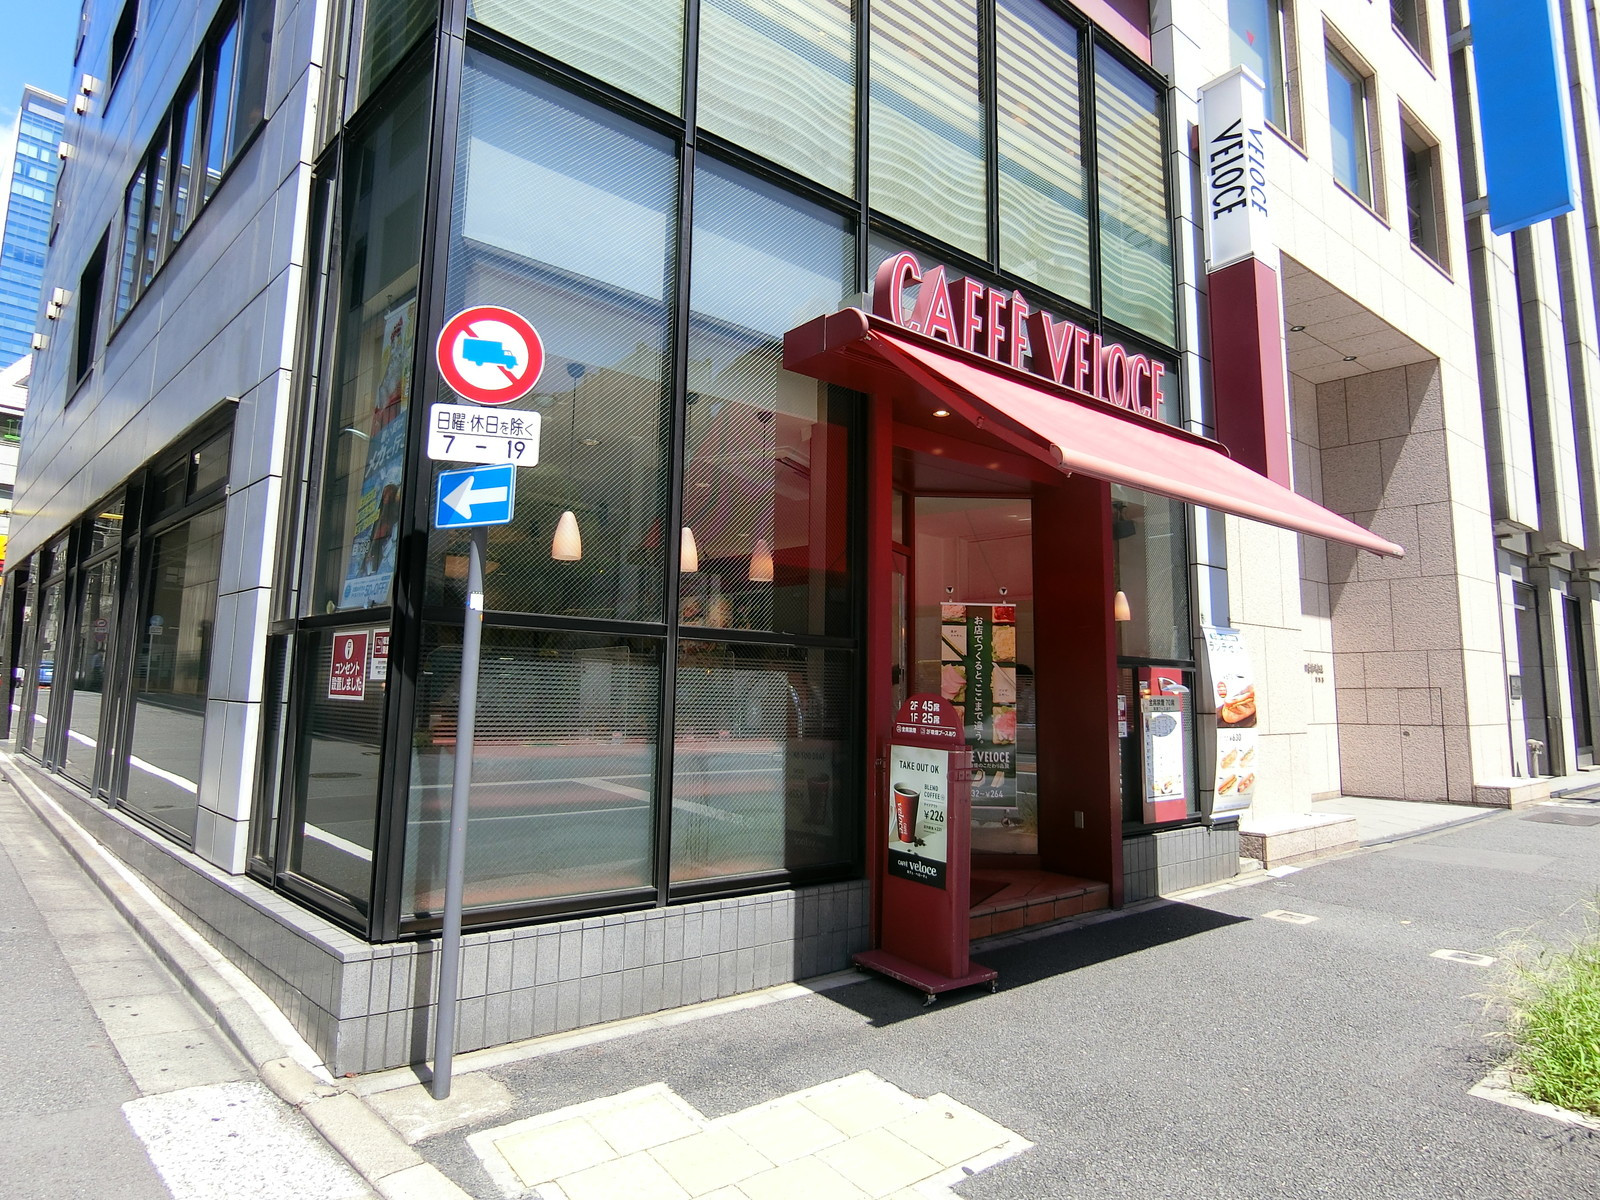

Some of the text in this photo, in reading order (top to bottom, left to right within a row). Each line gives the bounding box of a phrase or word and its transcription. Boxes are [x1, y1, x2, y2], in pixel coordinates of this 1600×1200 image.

[1210, 118, 1247, 221] VELOCE
[1248, 127, 1268, 218] VELOCE
[1029, 309, 1166, 422] VELOCE
[443, 434, 456, 454] 7
[506, 440, 526, 460] 19
[334, 661, 360, 676] コンセント
[331, 676, 362, 691] 設置しました
[910, 700, 940, 712] 2F 45席
[910, 712, 940, 725] 1F 25席
[977, 751, 1010, 763] VELOCE
[899, 760, 940, 774] TAKE OUT OK
[924, 783, 939, 792] BLEND
[923, 791, 940, 800] COFFEE
[923, 809, 944, 823] ¥226
[908, 860, 938, 877] veloce
